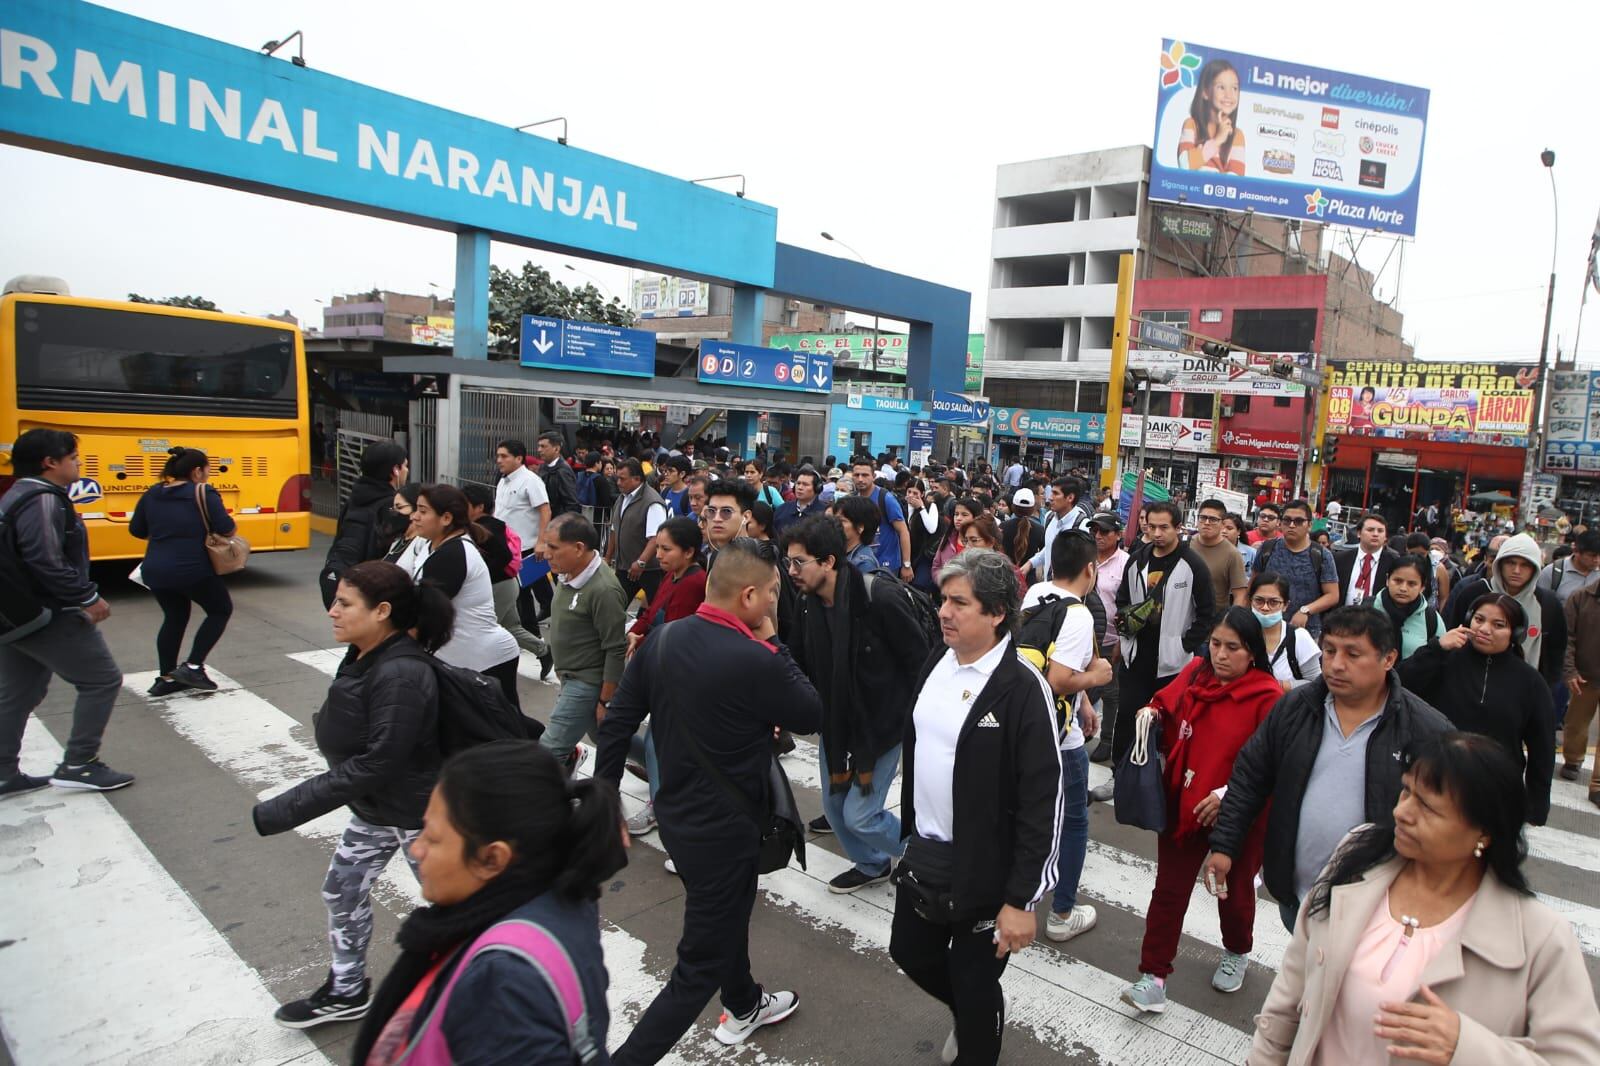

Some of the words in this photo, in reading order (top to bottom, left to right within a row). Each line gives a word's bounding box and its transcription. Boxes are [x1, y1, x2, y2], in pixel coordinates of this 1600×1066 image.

[1277, 74, 1329, 96] mejor
[1330, 82, 1416, 112] diversión!
[0, 29, 338, 163] RMINAL
[357, 123, 638, 231] NARANJAL
[1313, 165, 1343, 181] NOVA
[1239, 191, 1289, 205] plazanorte.pe
[1328, 199, 1366, 219] Plaza
[1367, 205, 1404, 225] Norte
[1182, 219, 1210, 230] PANEL
[1182, 227, 1212, 238] SHOCK
[531, 318, 557, 328] Ingreso
[834, 338, 850, 348] EL
[706, 356, 716, 372] B
[722, 358, 733, 373] D
[743, 361, 752, 375] 2
[778, 366, 786, 379] 5
[1345, 361, 1403, 373] CENTRO
[1405, 363, 1498, 375] COMERCIAL
[1253, 381, 1280, 389] AISIN
[1330, 371, 1419, 388] GALLITO
[1424, 374, 1456, 389] DE
[1461, 375, 1515, 390] ORO
[1440, 389, 1469, 399] CARLOS
[875, 399, 909, 411] TAQUILLA
[932, 400, 950, 411] SOLO
[950, 402, 973, 413] SALIDA
[1329, 398, 1351, 414] 08
[1479, 397, 1530, 423] LARCAY
[1019, 416, 1081, 433] SALVADOR
[1146, 422, 1172, 433] DAIK
[1234, 436, 1248, 446] San
[1248, 439, 1272, 449] Miguel
[1272, 440, 1300, 452] Arcáng
